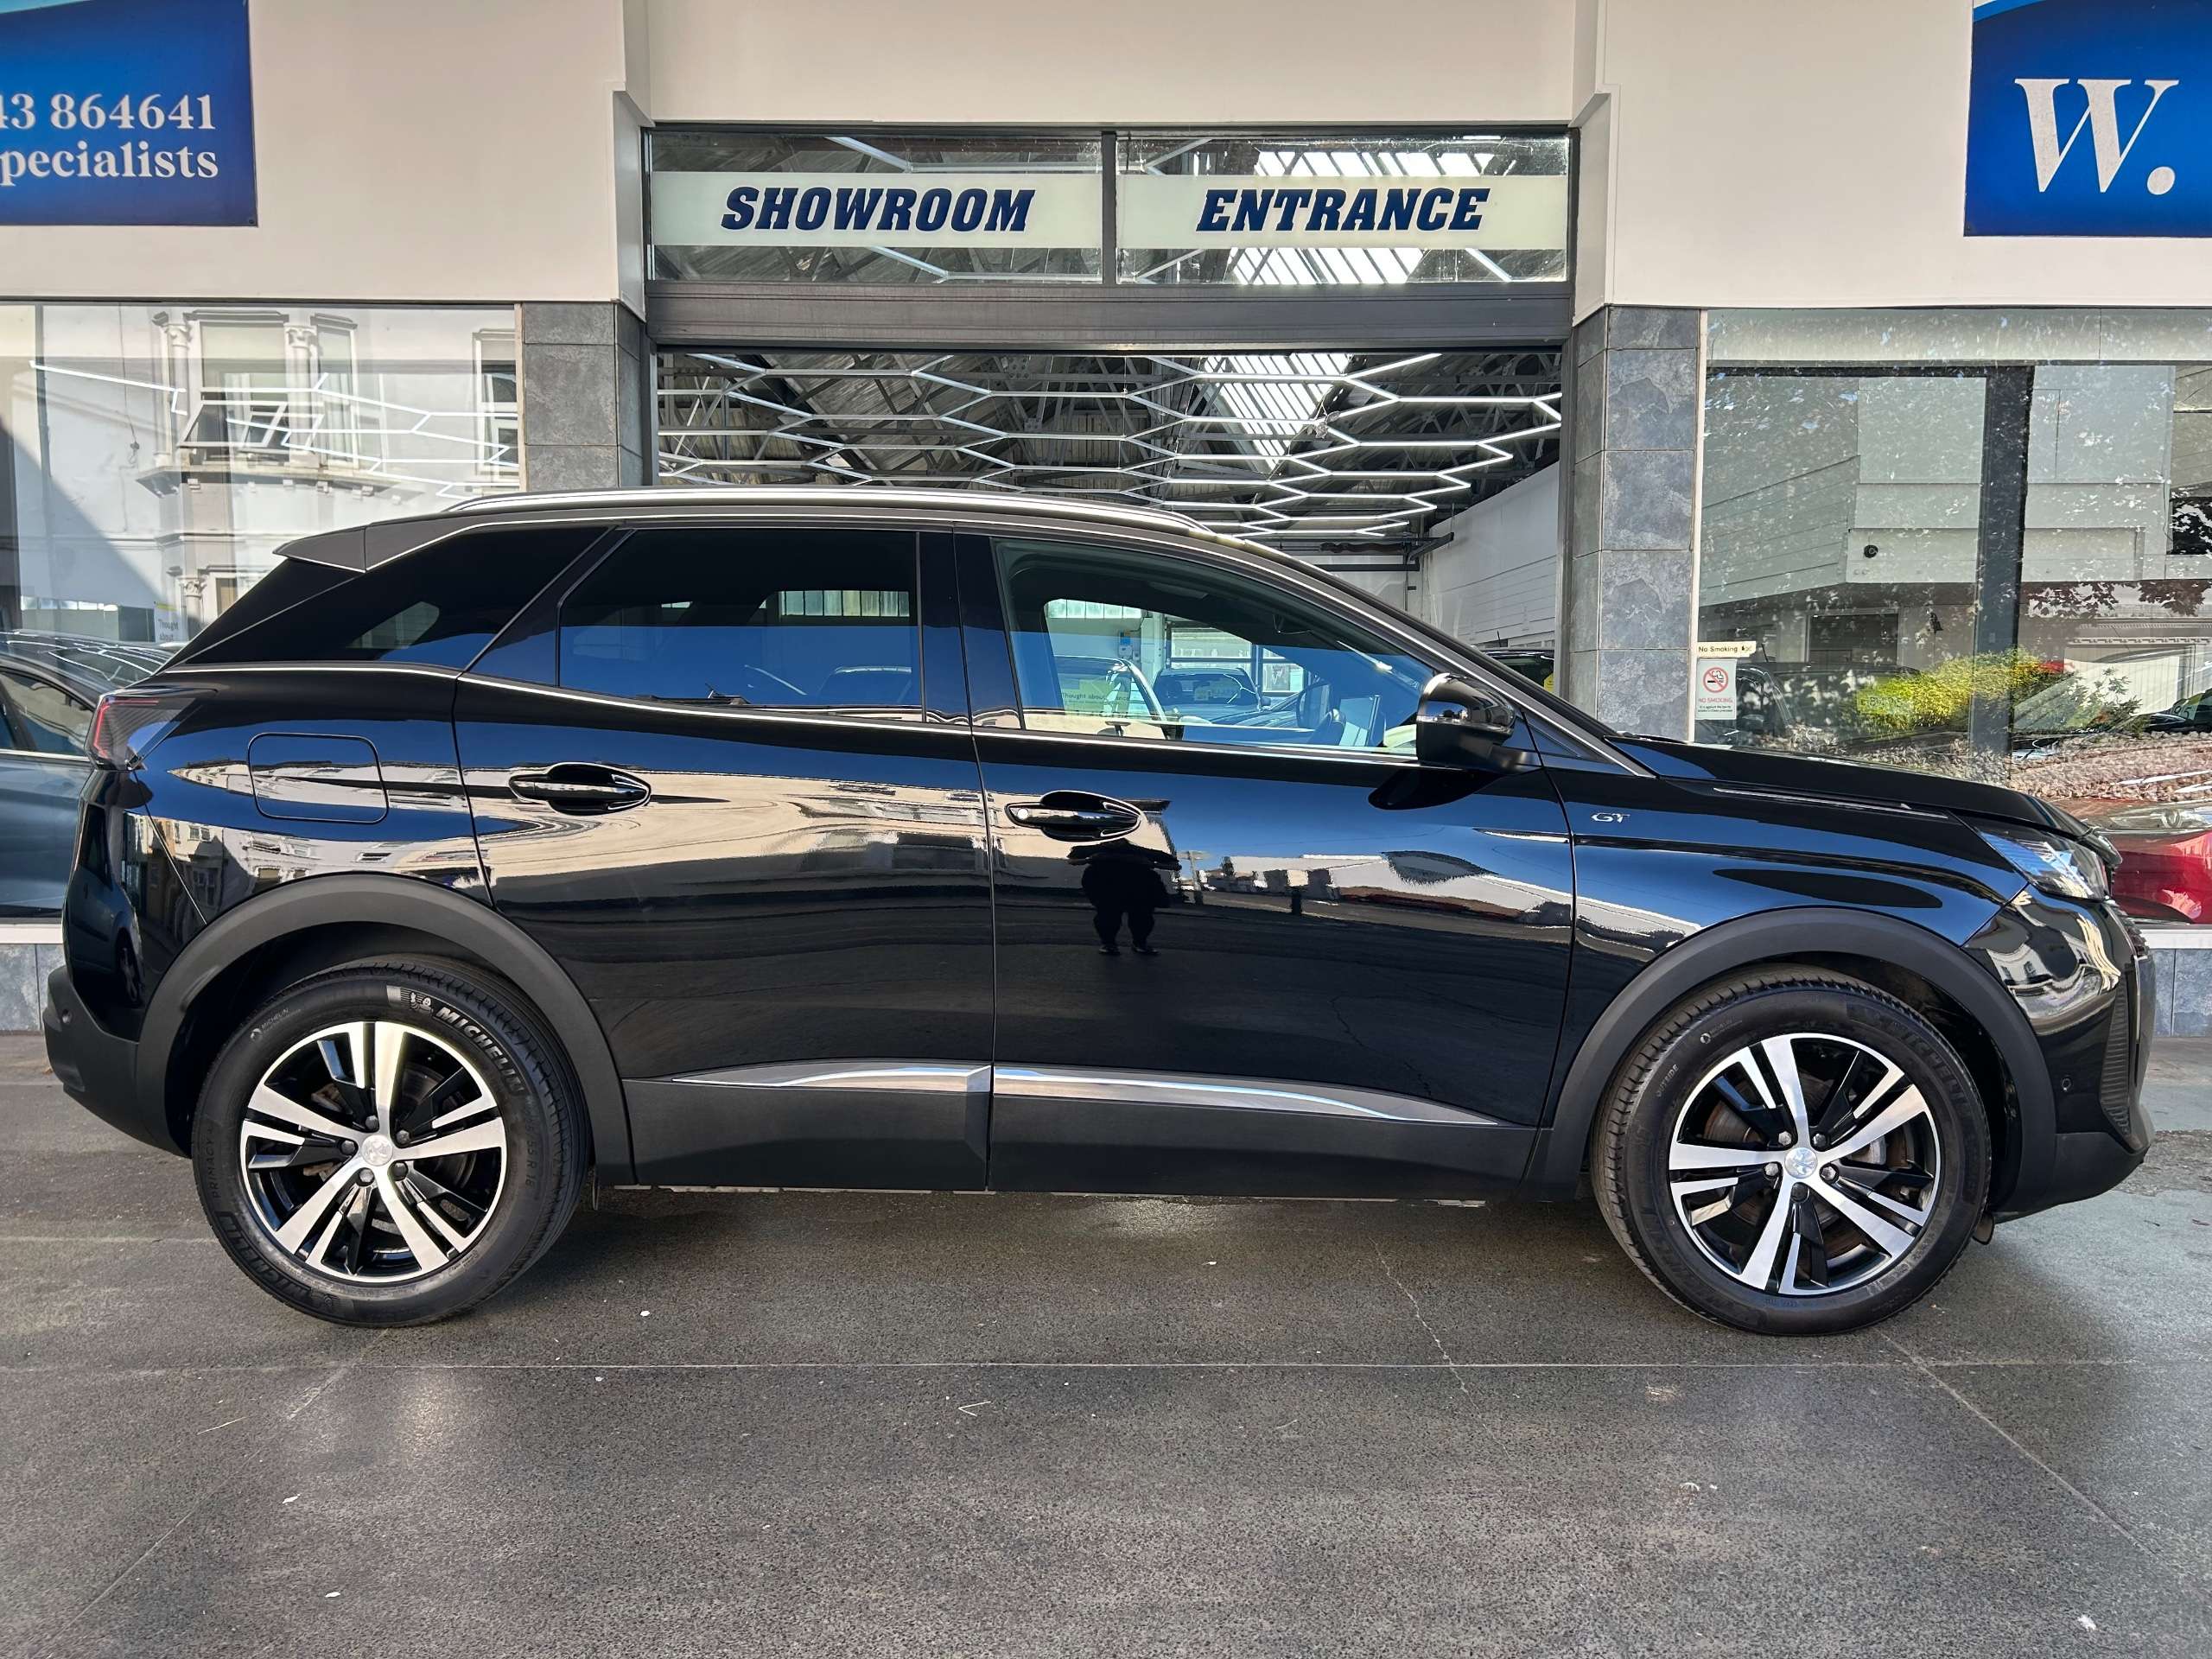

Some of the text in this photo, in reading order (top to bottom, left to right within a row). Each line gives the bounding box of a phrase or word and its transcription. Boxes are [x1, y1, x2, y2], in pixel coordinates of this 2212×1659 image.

[50, 93, 216, 130] 864641
[2014, 79, 2179, 195] W.
[721, 187, 1491, 232] SHOWROOM ENTRANCE
[1591, 812, 1630, 823] GT
[435, 1007, 525, 1093] MICHELIN
